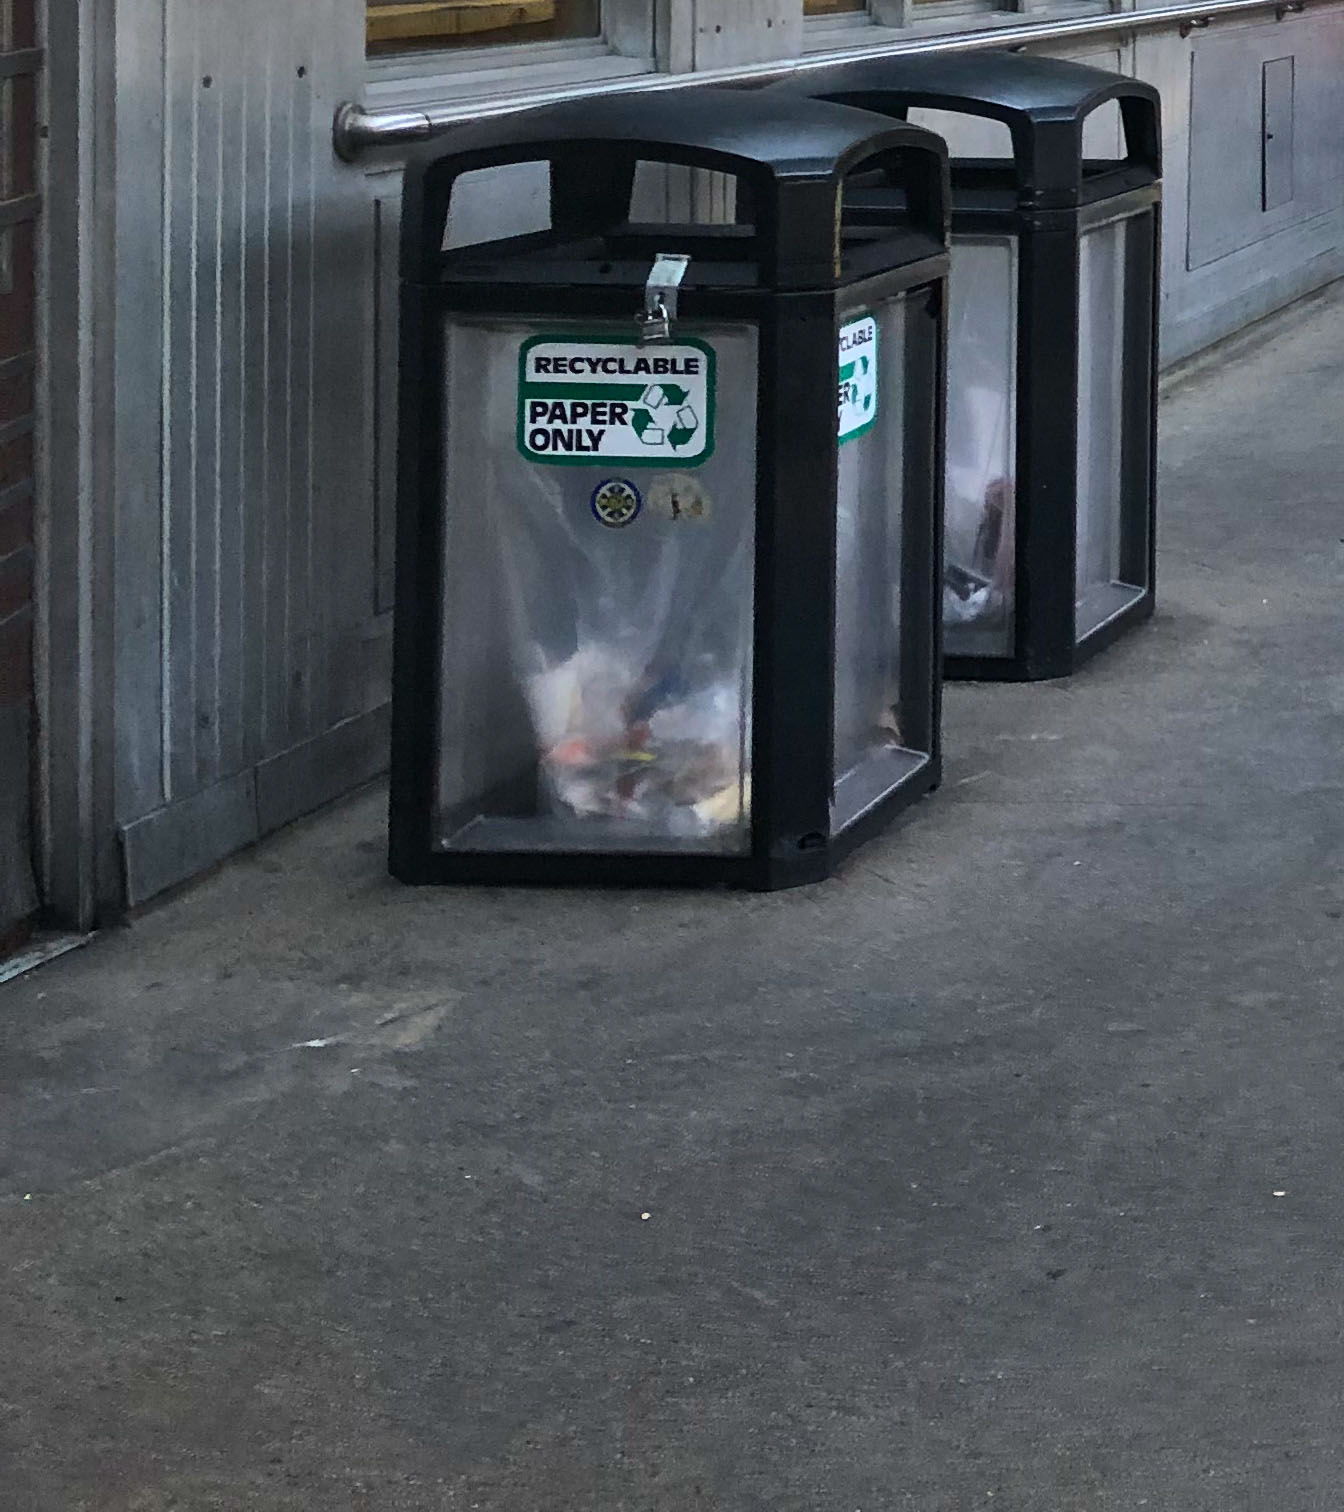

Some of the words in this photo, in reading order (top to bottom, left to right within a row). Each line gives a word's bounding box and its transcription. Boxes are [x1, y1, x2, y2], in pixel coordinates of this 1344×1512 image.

[840, 325, 873, 352] CLABLE
[534, 356, 700, 375] RECYCLABLE
[529, 400, 629, 426] PAPER
[528, 427, 606, 453] ONLY
